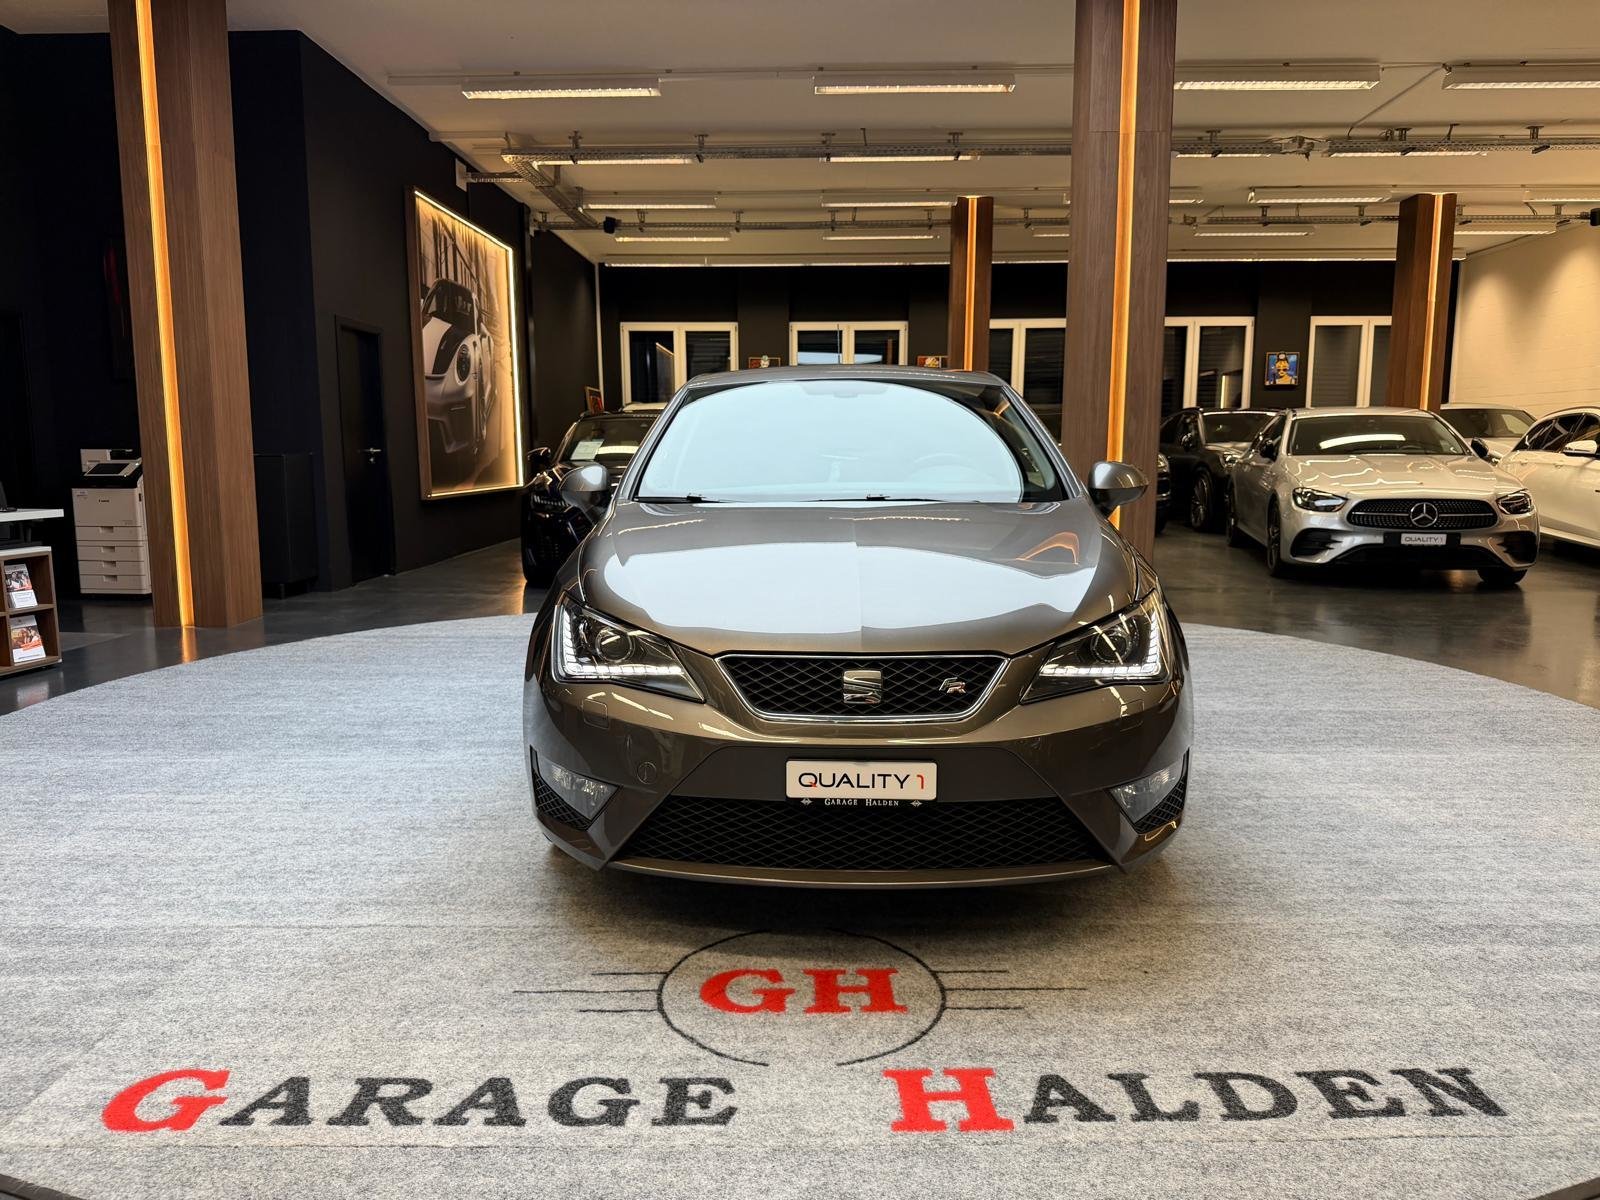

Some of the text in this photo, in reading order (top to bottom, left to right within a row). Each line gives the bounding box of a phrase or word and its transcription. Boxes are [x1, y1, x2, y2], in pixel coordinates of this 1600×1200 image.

[798, 772, 910, 789] QUALITY
[824, 798, 899, 806] GARAGE HALDEN
[700, 968, 908, 1014] GH
[102, 1067, 1507, 1132] GARAGE HALDEN
